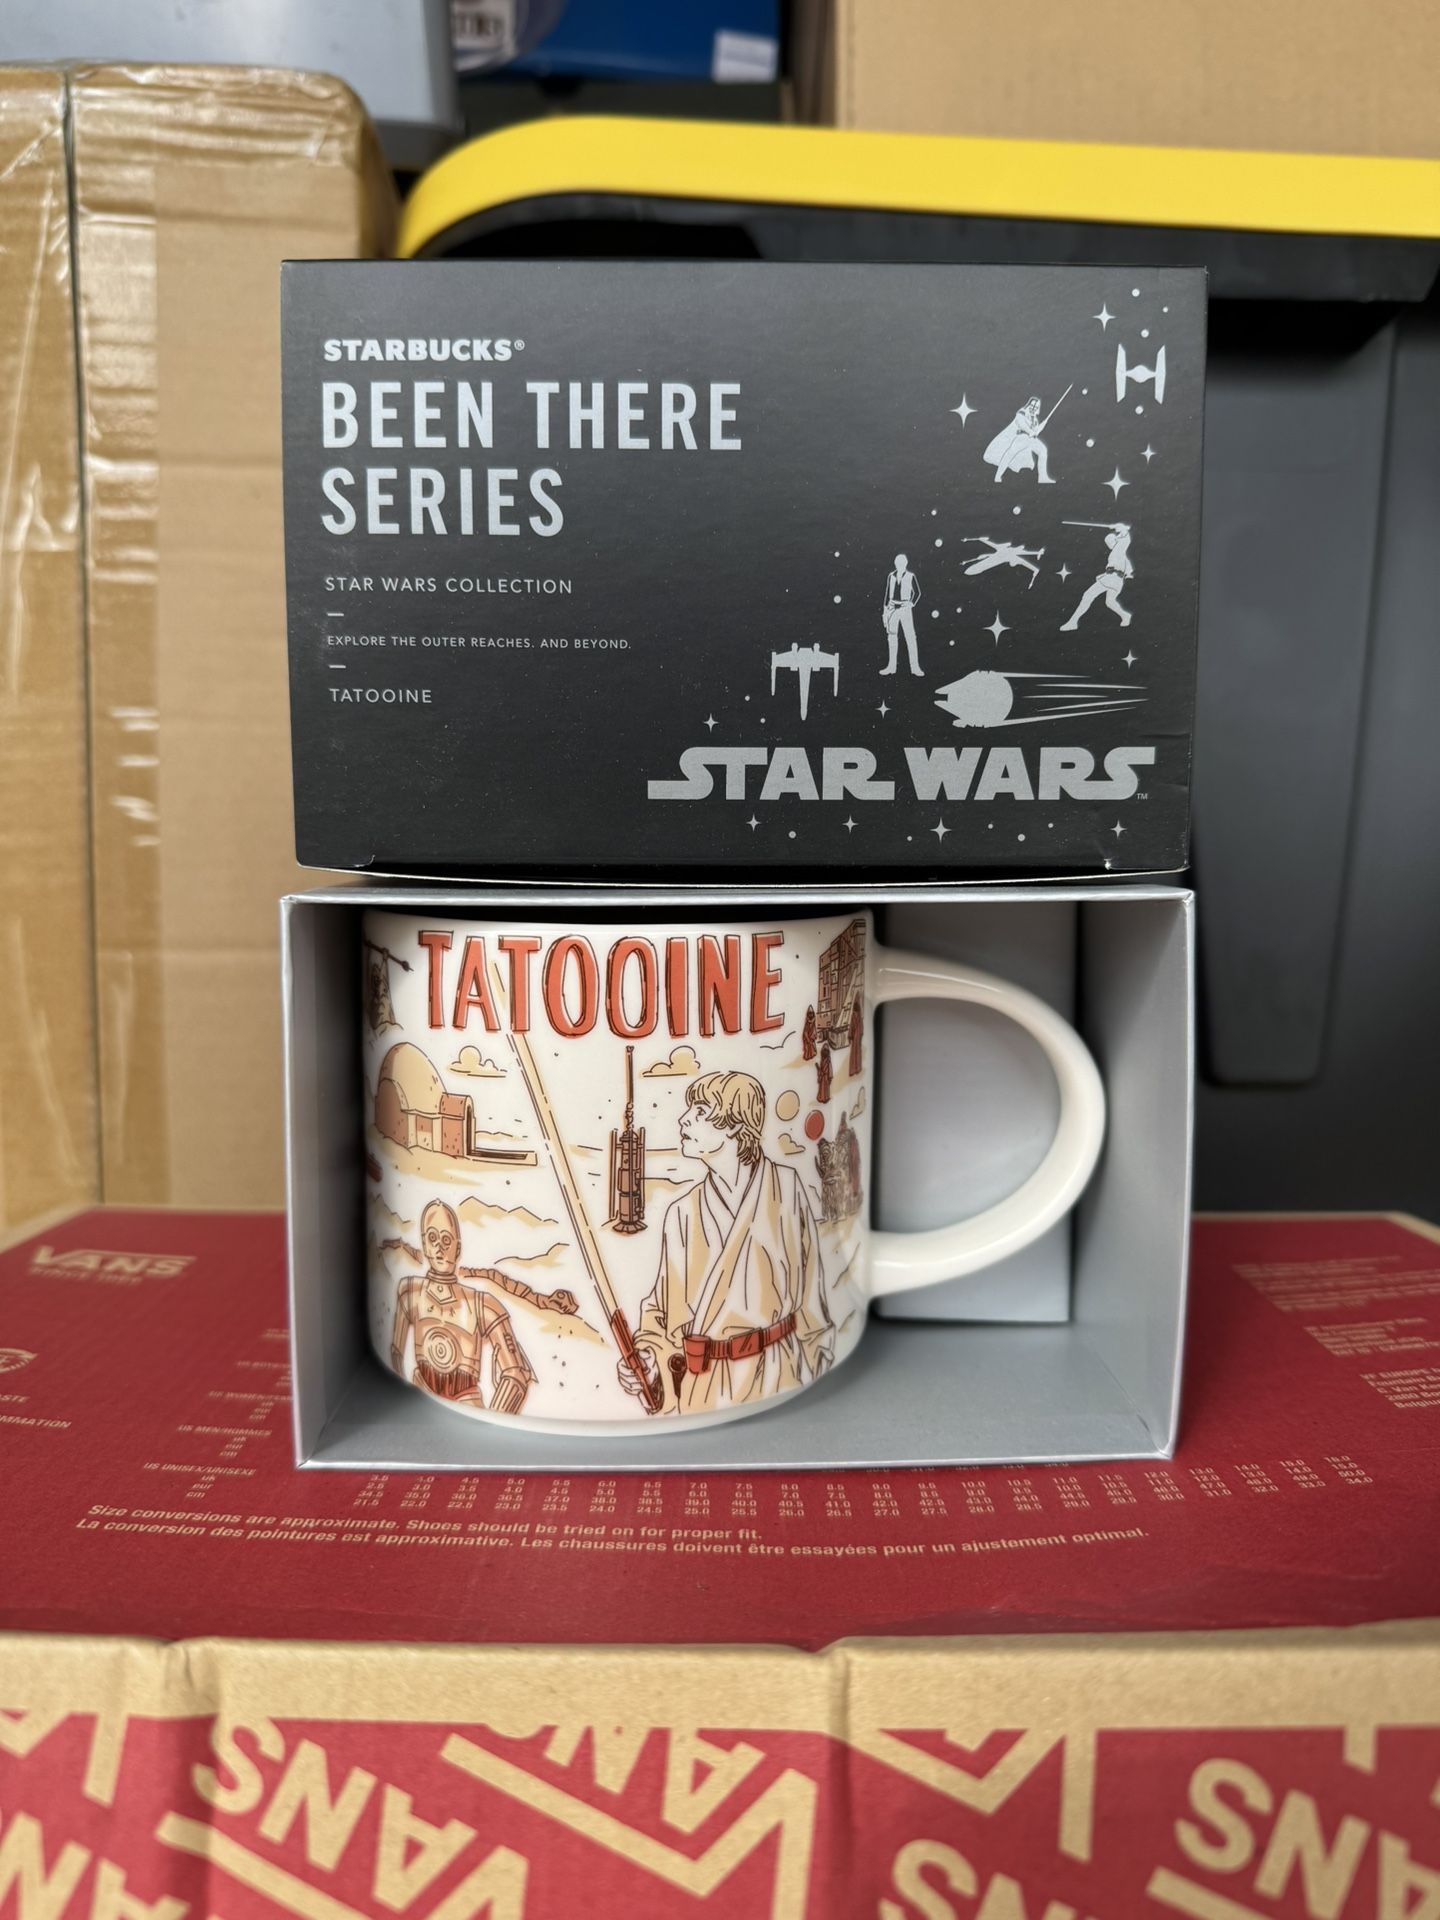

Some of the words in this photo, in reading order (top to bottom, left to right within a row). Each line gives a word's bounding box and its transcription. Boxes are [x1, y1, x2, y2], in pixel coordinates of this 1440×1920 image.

[322, 381, 494, 449] BEEN
[526, 382, 742, 451] THERE
[321, 468, 564, 537] SERIES
[325, 577, 374, 593] STAR
[381, 577, 438, 593] WARS
[446, 578, 573, 594] COLLECTION
[327, 635, 386, 647] EXPLORE
[391, 636, 417, 647] THE
[421, 636, 466, 648] OUTER
[471, 637, 535, 649] REACHES.
[540, 638, 569, 649] AND
[574, 638, 631, 649] BEYOND.
[329, 688, 432, 704] TATOOINE
[648, 747, 895, 800] STAR
[418, 930, 785, 1038] TATOOINE
[32, 1245, 198, 1277] VANS
[76, 1518, 99, 1529] La
[104, 1520, 207, 1535] conversion
[210, 1525, 244, 1537] des
[246, 1527, 336, 1541] pointures
[342, 1532, 371, 1542] est
[375, 1533, 514, 1547] approximative.
[521, 1537, 553, 1548] Les
[558, 1538, 667, 1551] chaussures
[673, 1541, 742, 1553] doivent
[748, 1541, 785, 1554] être
[790, 1543, 877, 1557] essayées
[883, 1543, 925, 1556] pour
[932, 1543, 956, 1553] un
[961, 1533, 1067, 1553] ajustement
[1072, 1527, 1150, 1544] optimal.
[87, 1504, 128, 1518] Size
[131, 1508, 243, 1524] conversions
[246, 1514, 275, 1525] are
[280, 1516, 400, 1530] approximate.
[406, 1519, 462, 1531] Shoes
[468, 1521, 530, 1533] should
[535, 1523, 558, 1534] be
[563, 1524, 606, 1535] tried
[612, 1527, 634, 1536] on
[639, 1526, 666, 1537] for
[672, 1529, 732, 1540] proper
[738, 1528, 762, 1539] fit.
